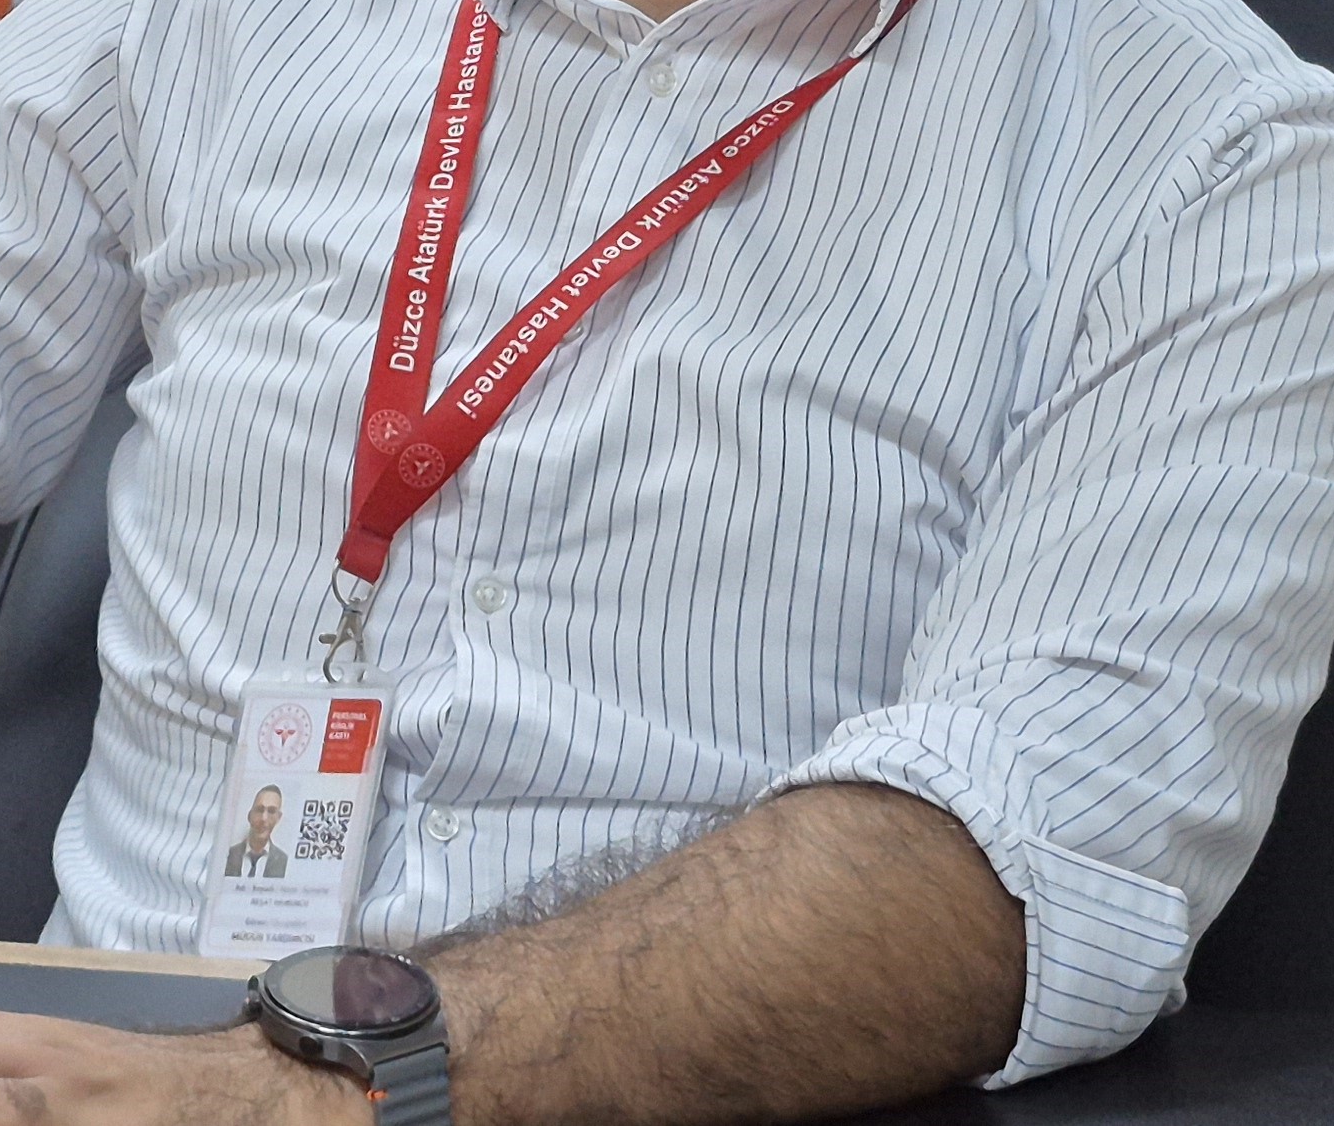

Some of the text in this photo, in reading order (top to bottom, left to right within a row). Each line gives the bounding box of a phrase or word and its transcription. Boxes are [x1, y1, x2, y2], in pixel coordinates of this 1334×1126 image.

[429, 114, 468, 191] Devlet
[407, 195, 450, 285] Atatürk
[455, 100, 796, 421] Düzce Atatürk Devlet Hastanesi
[389, 289, 427, 373] Düzce
